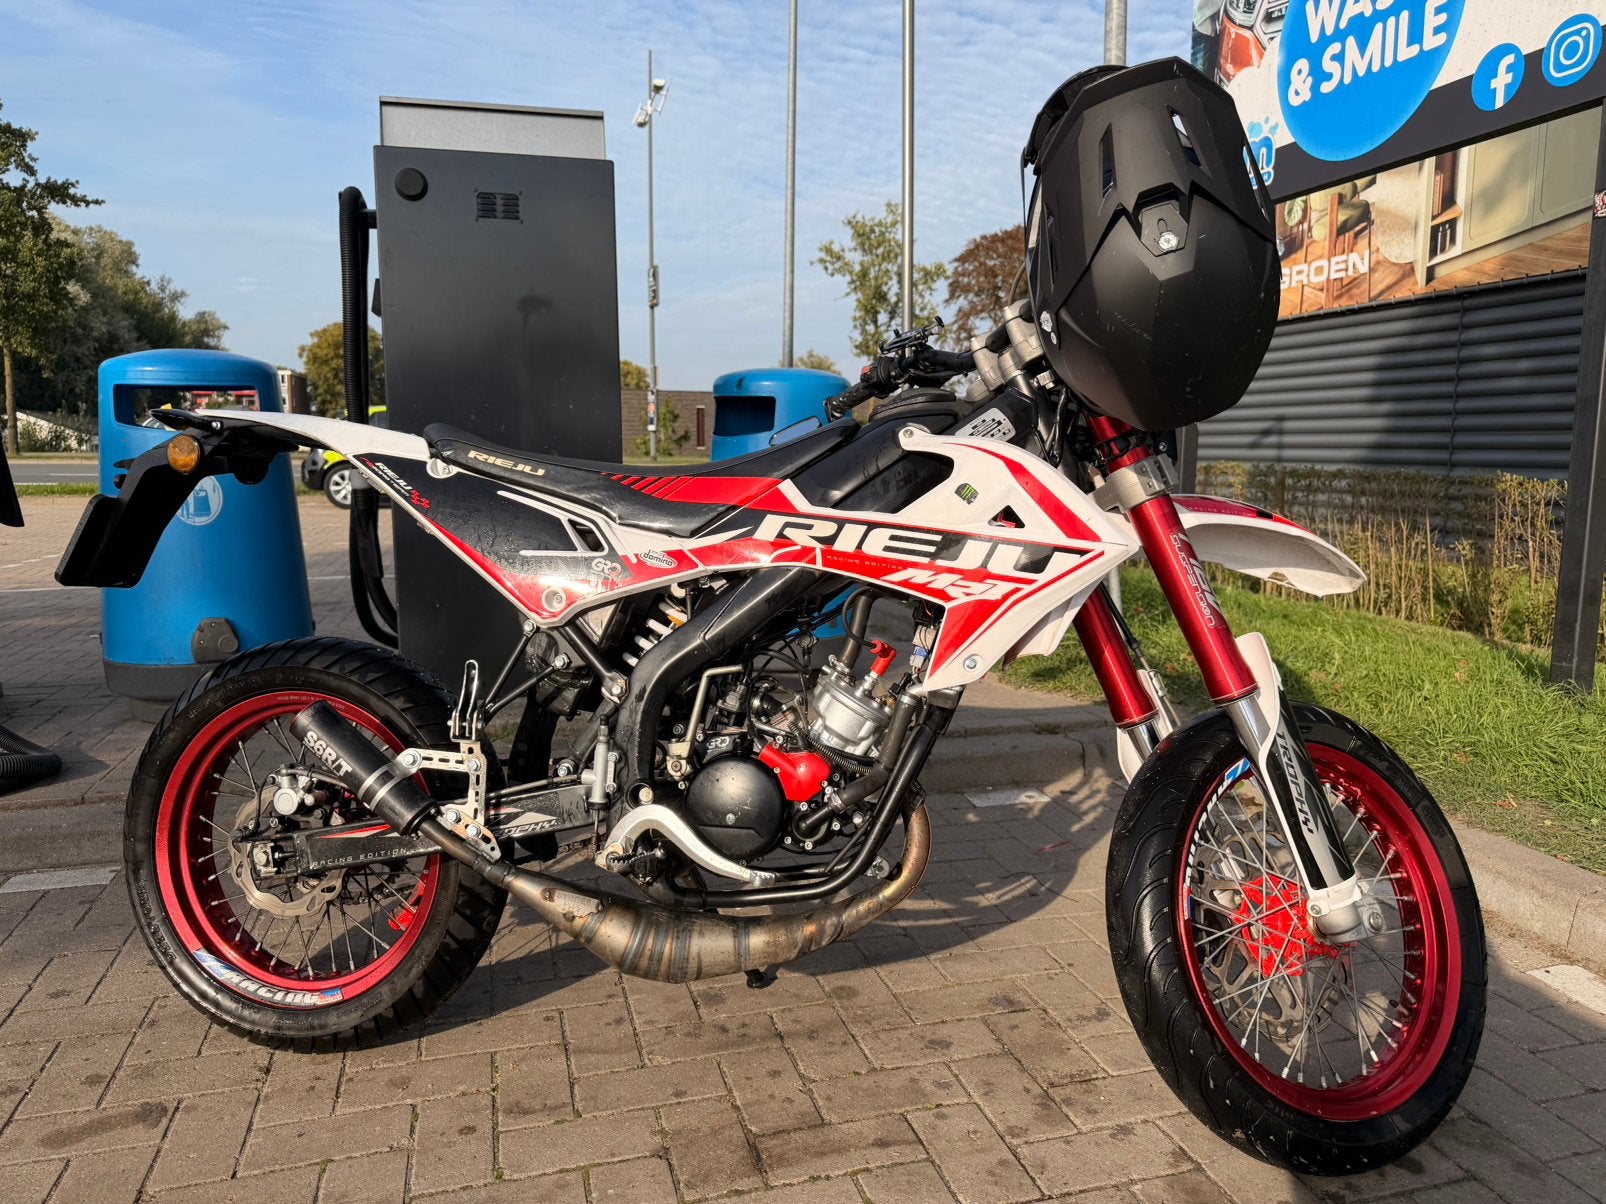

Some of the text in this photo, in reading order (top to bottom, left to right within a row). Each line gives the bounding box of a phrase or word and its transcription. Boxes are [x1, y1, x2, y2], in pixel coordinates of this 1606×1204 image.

[1305, 0, 1395, 43] WA
[1288, 0, 1448, 107] & SMILE
[375, 462, 413, 490] RIEJU
[467, 450, 546, 476] RIEJU
[752, 514, 1085, 583] RIEJU
[864, 561, 903, 570] EDITION
[880, 567, 1025, 601] MRT
[1276, 731, 1315, 835] TROPHY
[310, 847, 407, 869] RACING EDITION
